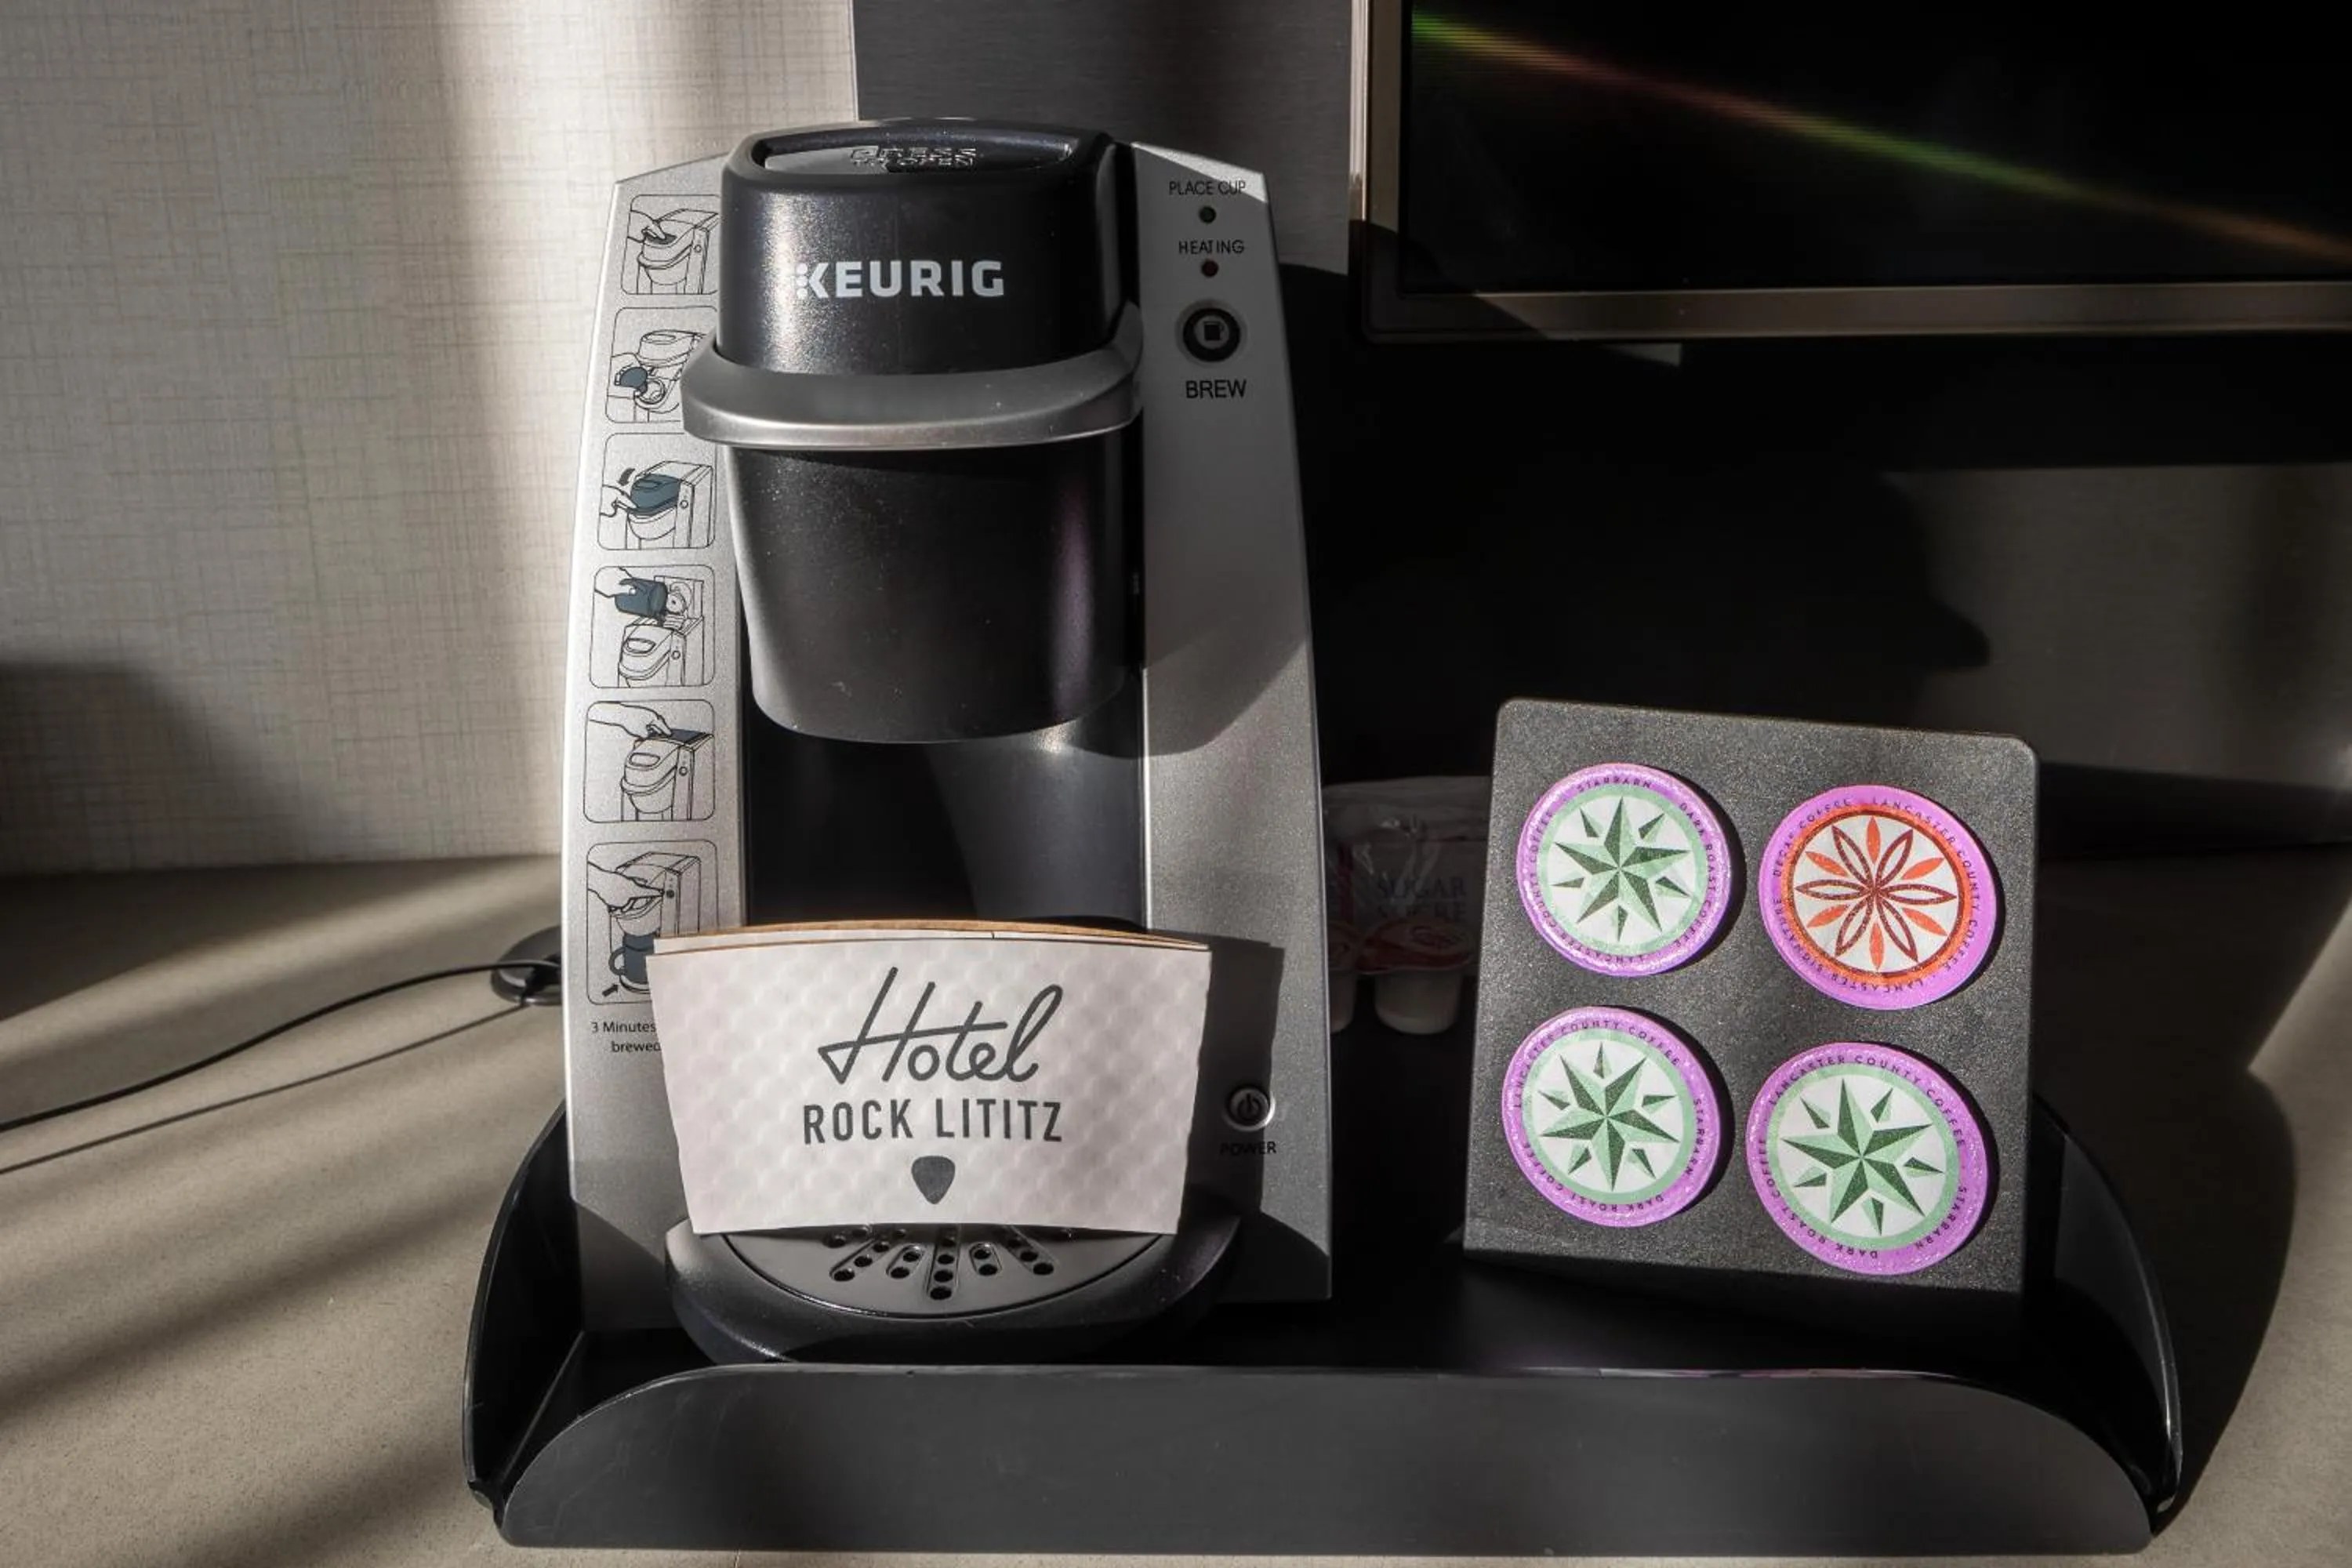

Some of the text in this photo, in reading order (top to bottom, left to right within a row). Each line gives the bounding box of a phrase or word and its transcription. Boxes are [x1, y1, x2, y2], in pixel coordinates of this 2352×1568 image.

[1169, 180, 1246, 195] PLACE CUP
[1178, 239, 1245, 254] HEATING
[796, 260, 1004, 298] KEURIG
[1185, 379, 1247, 399] BREW
[1679, 803, 1705, 836] DARK
[1873, 798, 1956, 844] LANCASTER
[1957, 850, 1979, 909] COUNTY
[591, 1021, 657, 1033] 3 Minutes
[817, 966, 1063, 1084] Hotel
[1769, 1055, 1965, 1147] LANCASTER COUNTY COFFEE
[803, 1098, 1062, 1145] ROCK LITITZ
[1220, 1141, 1276, 1156] POWER
[1759, 1139, 1780, 1199] COFFEE
[1628, 1194, 1664, 1211] DARK
[1915, 1186, 1968, 1250] STARBARN
[1835, 1243, 1878, 1258] DARK
